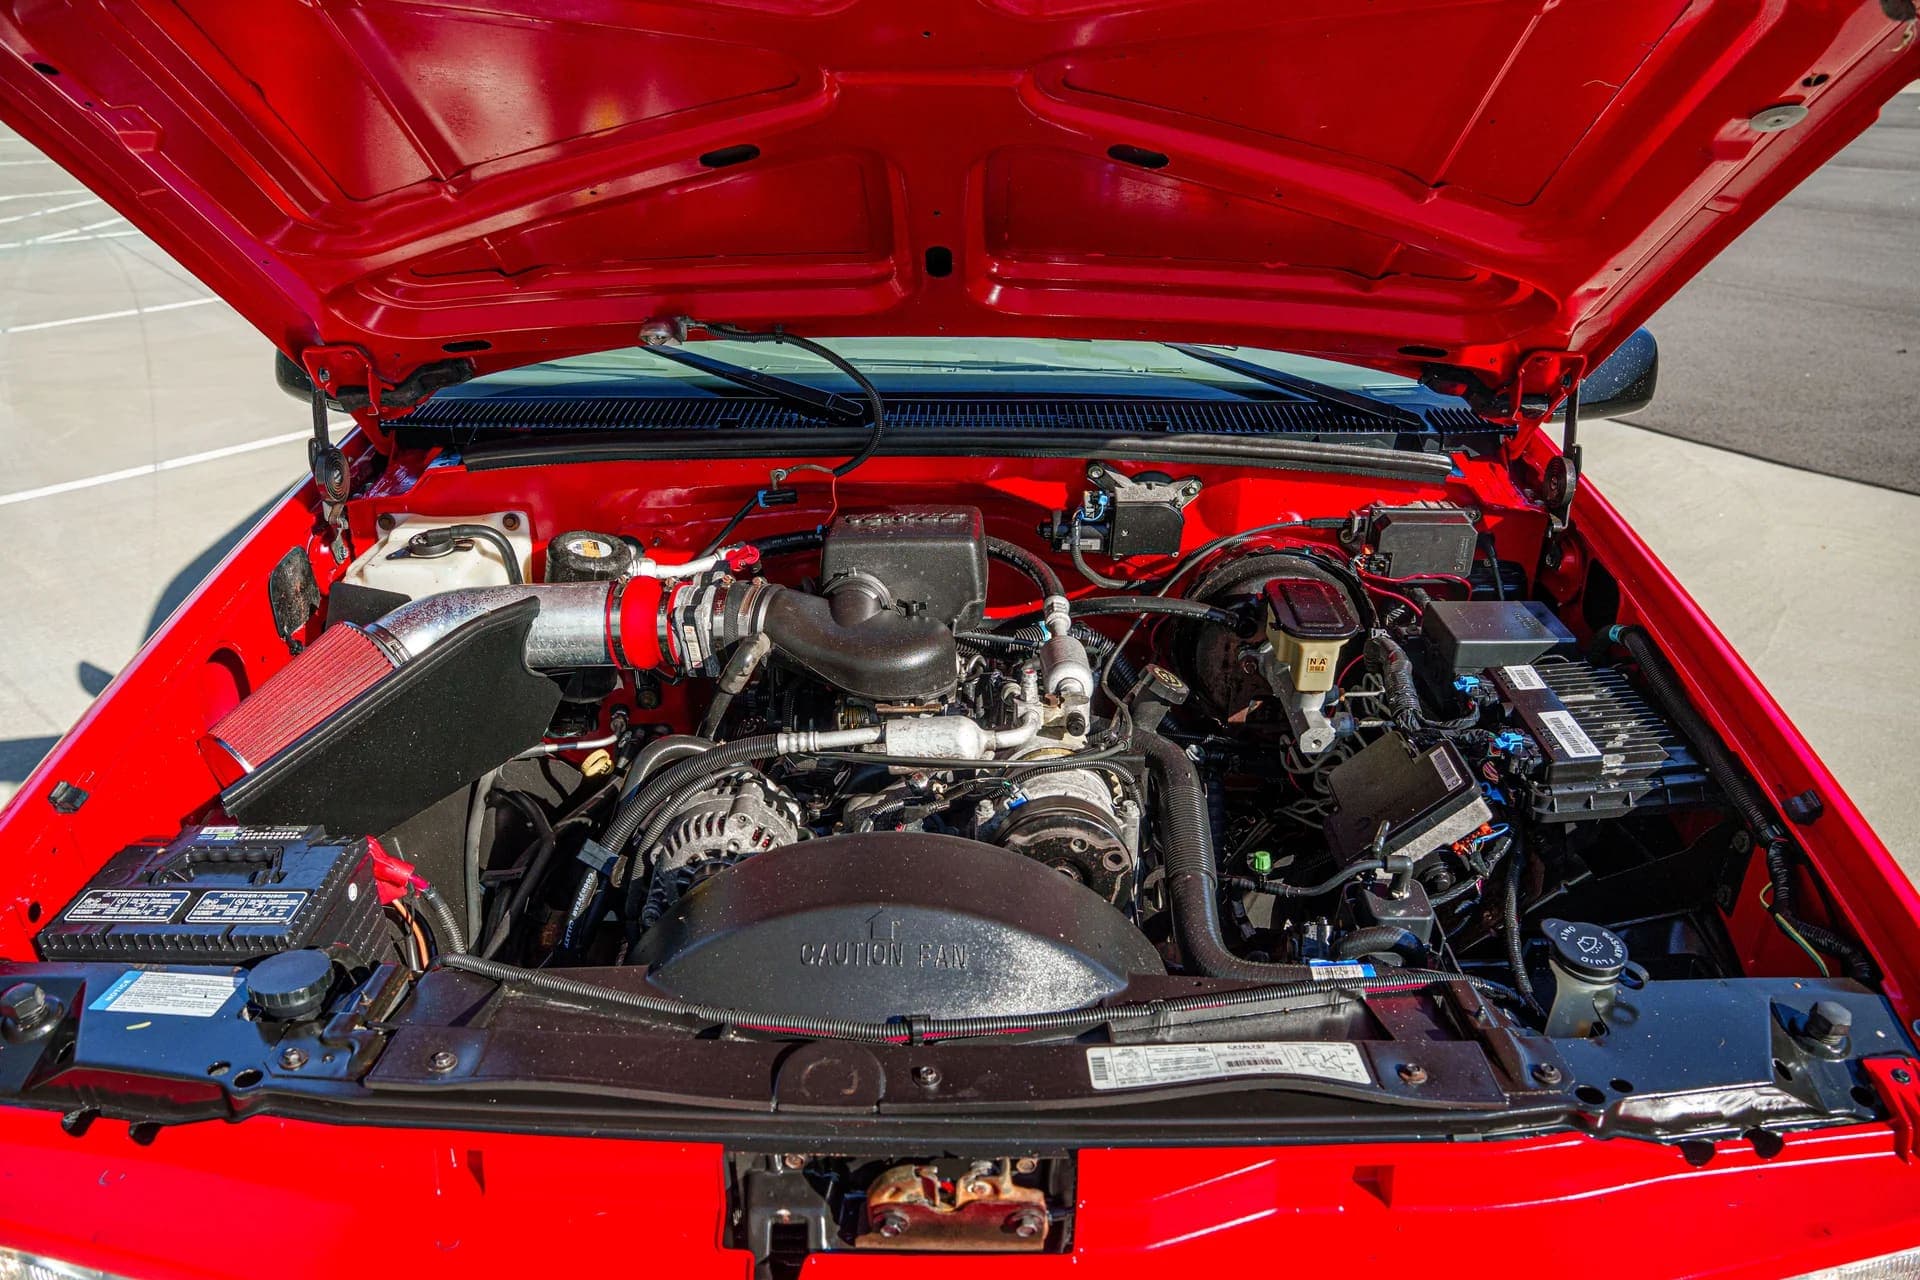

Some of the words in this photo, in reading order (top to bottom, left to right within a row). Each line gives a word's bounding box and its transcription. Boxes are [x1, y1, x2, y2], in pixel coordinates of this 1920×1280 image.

[1560, 925, 1577, 942] ONLY
[1601, 931, 1624, 958] WASHER
[800, 942, 904, 968] CAUTION
[918, 943, 968, 969] FAN
[1580, 956, 1616, 966] FLUID
